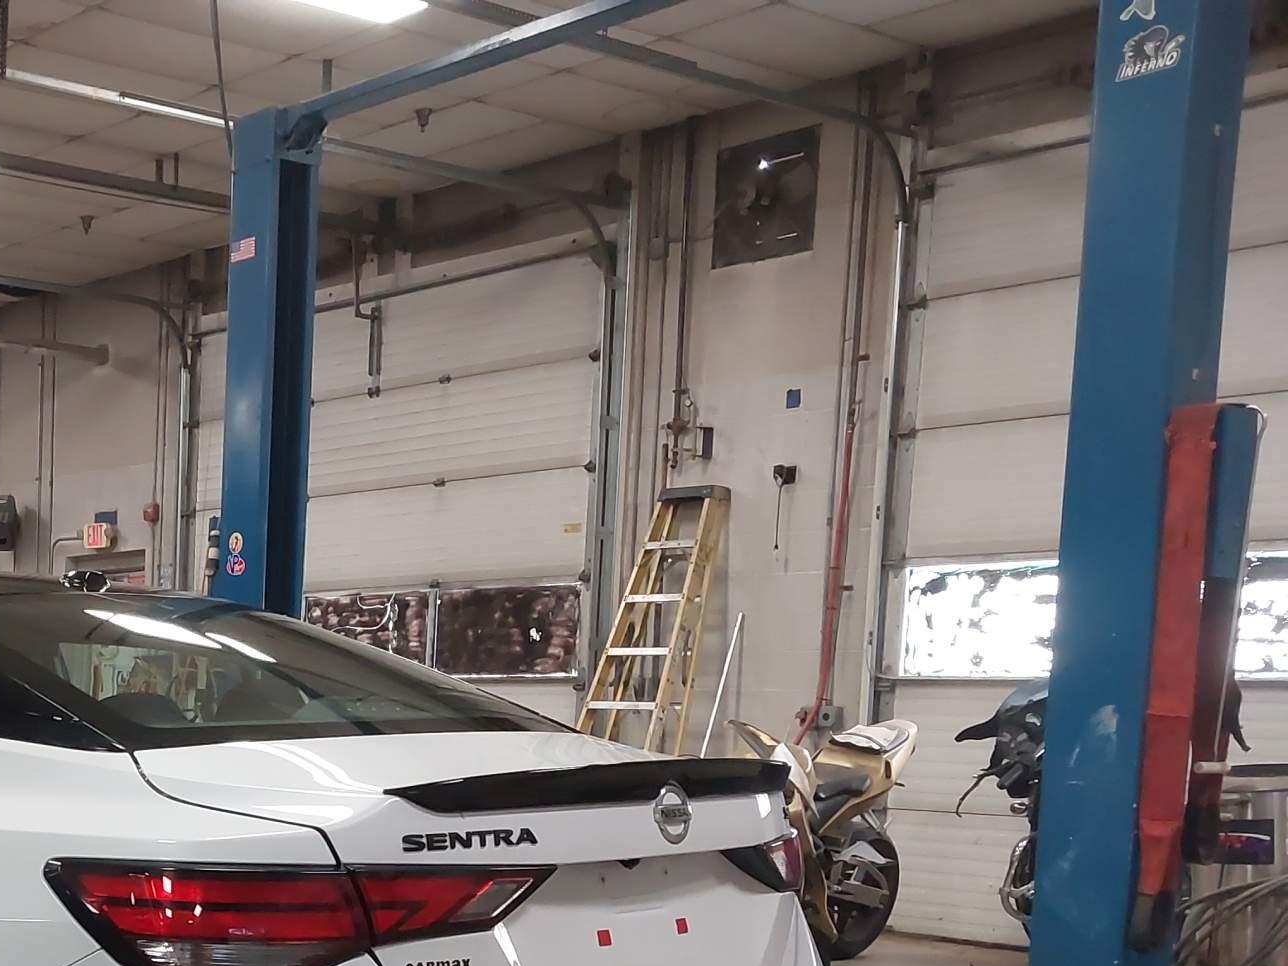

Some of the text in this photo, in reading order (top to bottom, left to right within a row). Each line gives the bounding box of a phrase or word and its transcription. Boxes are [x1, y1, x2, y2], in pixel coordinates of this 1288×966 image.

[1118, 50, 1179, 80] INFERNO
[87, 524, 105, 547] EXIT
[401, 827, 539, 853] SENTRA
